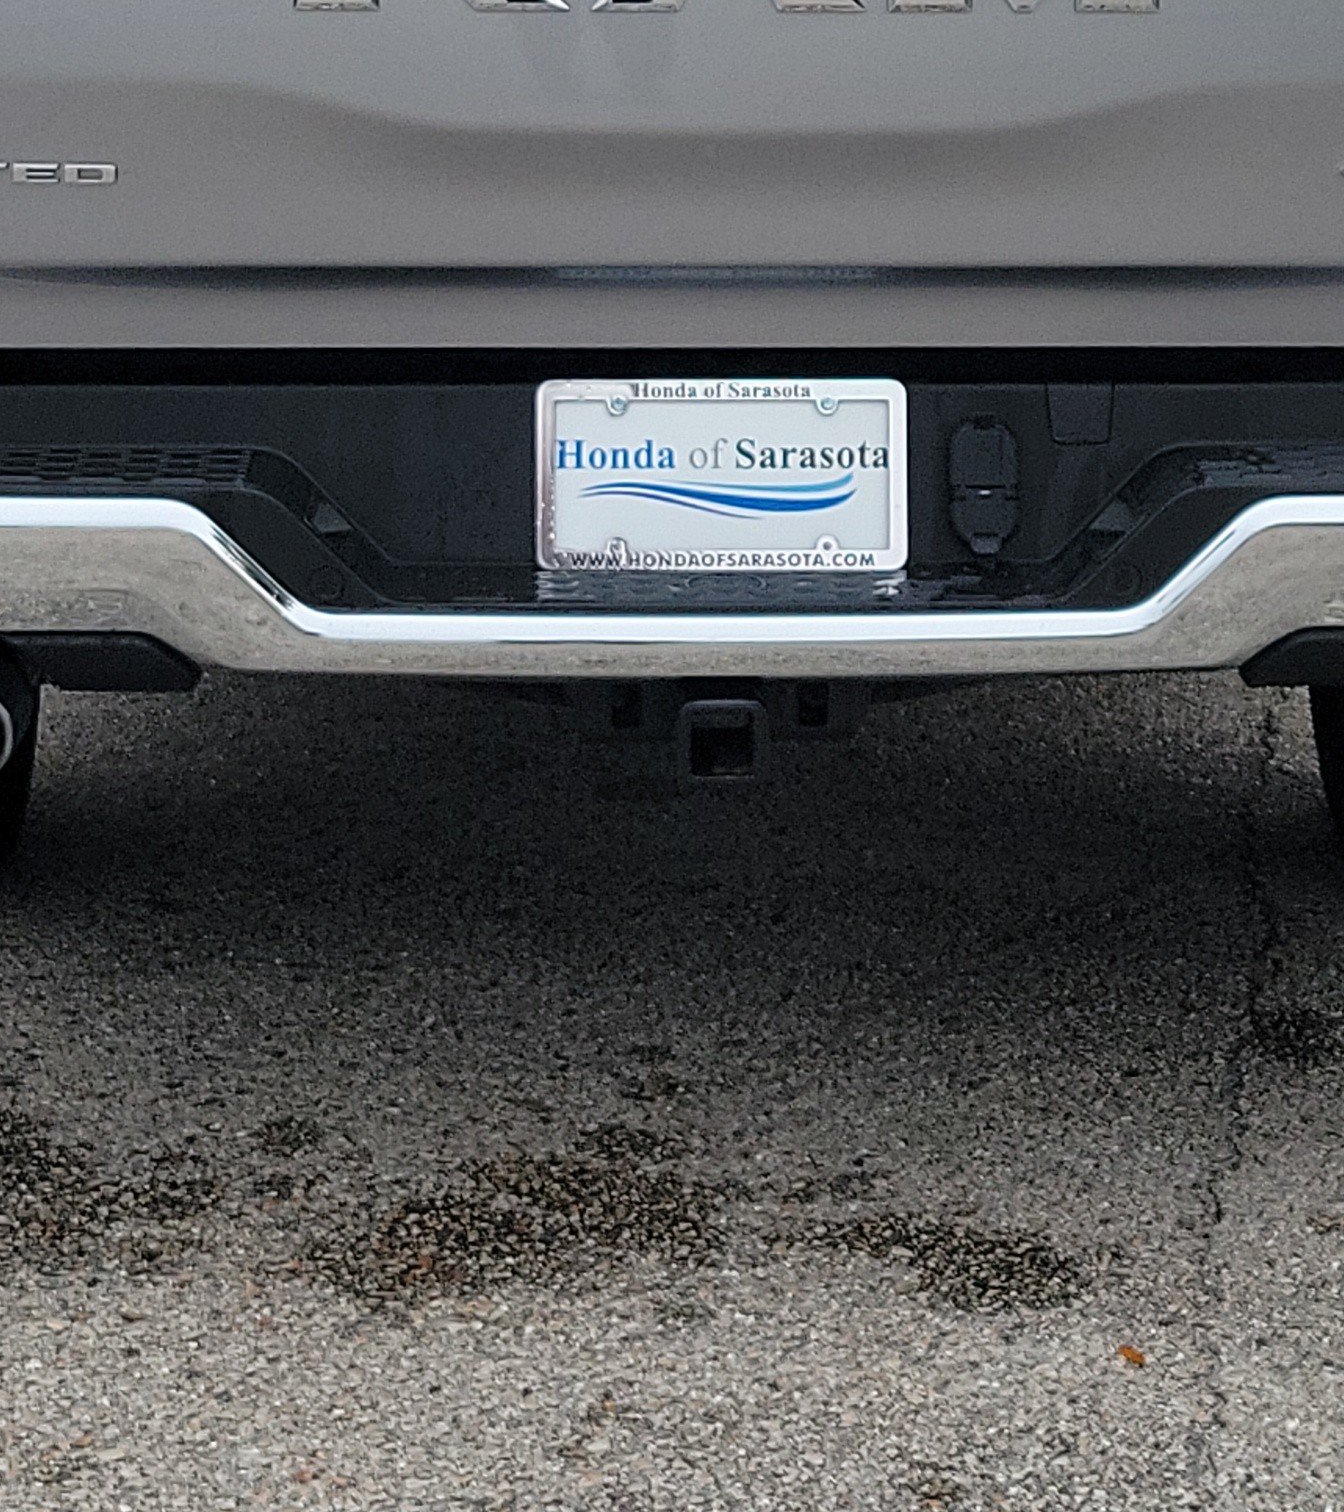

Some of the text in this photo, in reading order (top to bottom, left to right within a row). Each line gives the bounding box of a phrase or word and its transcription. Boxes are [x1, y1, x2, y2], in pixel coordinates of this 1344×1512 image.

[632, 381, 811, 398] Honda of Sarasota
[557, 437, 890, 469] Honda of Sarasota
[570, 551, 875, 569] WWW.HONDAOFSARASOTA.COM
